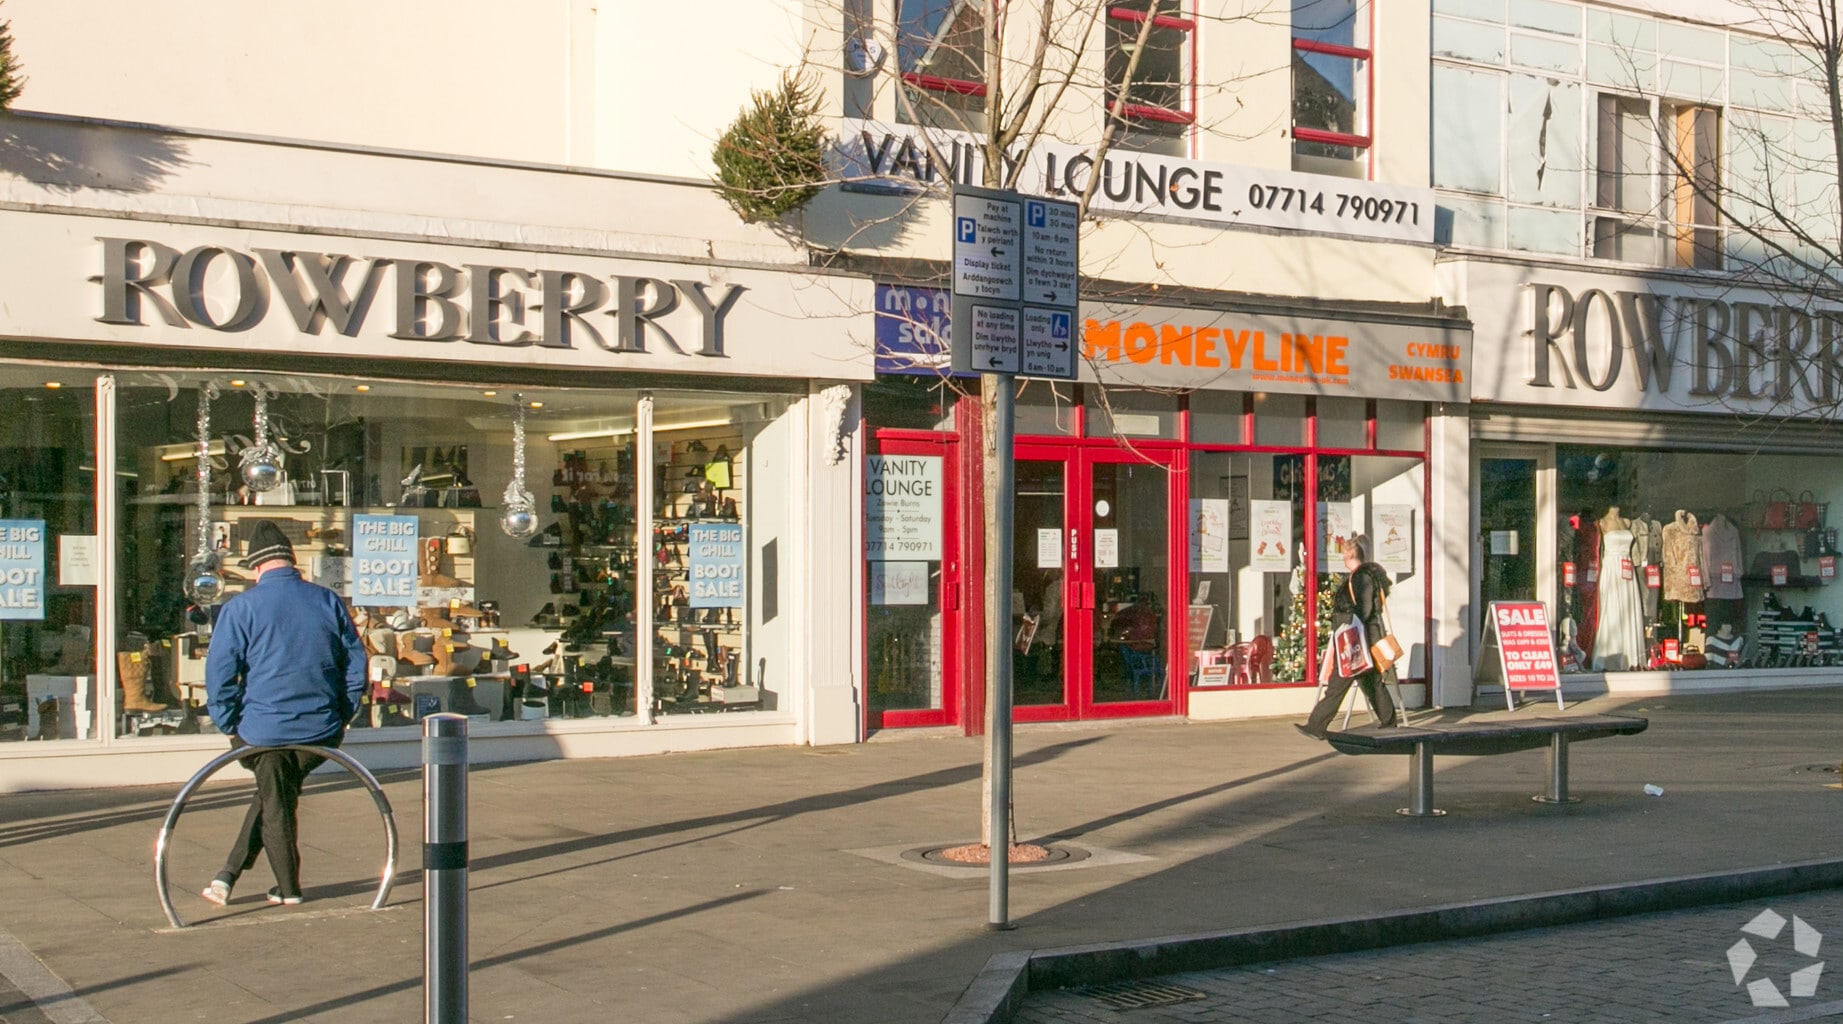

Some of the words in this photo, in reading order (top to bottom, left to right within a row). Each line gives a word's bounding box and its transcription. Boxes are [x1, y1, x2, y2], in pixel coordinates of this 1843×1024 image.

[1046, 153, 1223, 211] LOUNGE
[1249, 183, 1325, 215] 07714
[1336, 193, 1419, 225] 790971
[987, 202, 999, 213] Pay
[1001, 205, 1009, 213] at
[983, 213, 1011, 223] machine
[1032, 205, 1044, 226] P
[1060, 210, 1075, 218] mins
[961, 219, 974, 241] P
[977, 224, 1001, 235] Talwch
[1002, 228, 1018, 236] wrth
[1061, 222, 1075, 230] mun
[987, 236, 1014, 246] peiriant
[1034, 245, 1044, 254] No
[1046, 248, 1067, 256] return
[964, 258, 990, 270] Display
[991, 262, 1011, 271] ticket
[1027, 256, 1047, 264] within
[1055, 258, 1074, 267] hours
[963, 272, 1014, 285] Arddangoswch
[1026, 267, 1039, 275] Dim
[1041, 269, 1075, 280] dychwelyd
[975, 285, 980, 293] y
[981, 285, 1001, 294] tocyn
[1035, 278, 1051, 286] fewn
[1059, 281, 1071, 289] awr
[87, 236, 751, 357] ROWBERRY
[977, 310, 987, 318] No
[990, 311, 1014, 322] loading
[1025, 314, 1051, 324] Loading
[985, 322, 998, 330] any
[1000, 321, 1015, 330] time
[1031, 324, 1045, 334] only
[975, 332, 989, 340] Dim
[990, 333, 1016, 344] llwytho
[1026, 339, 1052, 349] Llwytho
[974, 343, 999, 354] unrhyw
[1001, 345, 1017, 354] bryd
[1085, 319, 1349, 375] MONEYLINE
[1406, 342, 1460, 360] CYMRU
[1036, 350, 1051, 359] unig
[1388, 364, 1463, 383] SWANSEA
[870, 458, 927, 476] VANITY
[865, 479, 932, 496] LOUNGE
[900, 499, 920, 507] Burns
[901, 514, 931, 524] Saturday
[10, 527, 40, 542] BIG
[358, 521, 387, 535] THE
[389, 522, 415, 536] BIG
[902, 526, 918, 534] 5pm
[692, 529, 718, 542] THE
[720, 530, 741, 542] BIG
[365, 538, 408, 552] CHILL
[701, 544, 736, 557] CHILL
[898, 542, 933, 551] 790971
[0, 545, 32, 559] HILL
[359, 558, 413, 576] BOOT
[694, 563, 740, 579] BOOT
[358, 577, 413, 596] SALE
[695, 580, 741, 598] SALE
[1498, 609, 1546, 626] SALE
[1505, 651, 1520, 660] TO
[1521, 650, 1551, 660] CLEAR
[1507, 661, 1532, 670] ONLY
[1534, 660, 1553, 670] £49
[1509, 674, 1527, 682] SIZES
